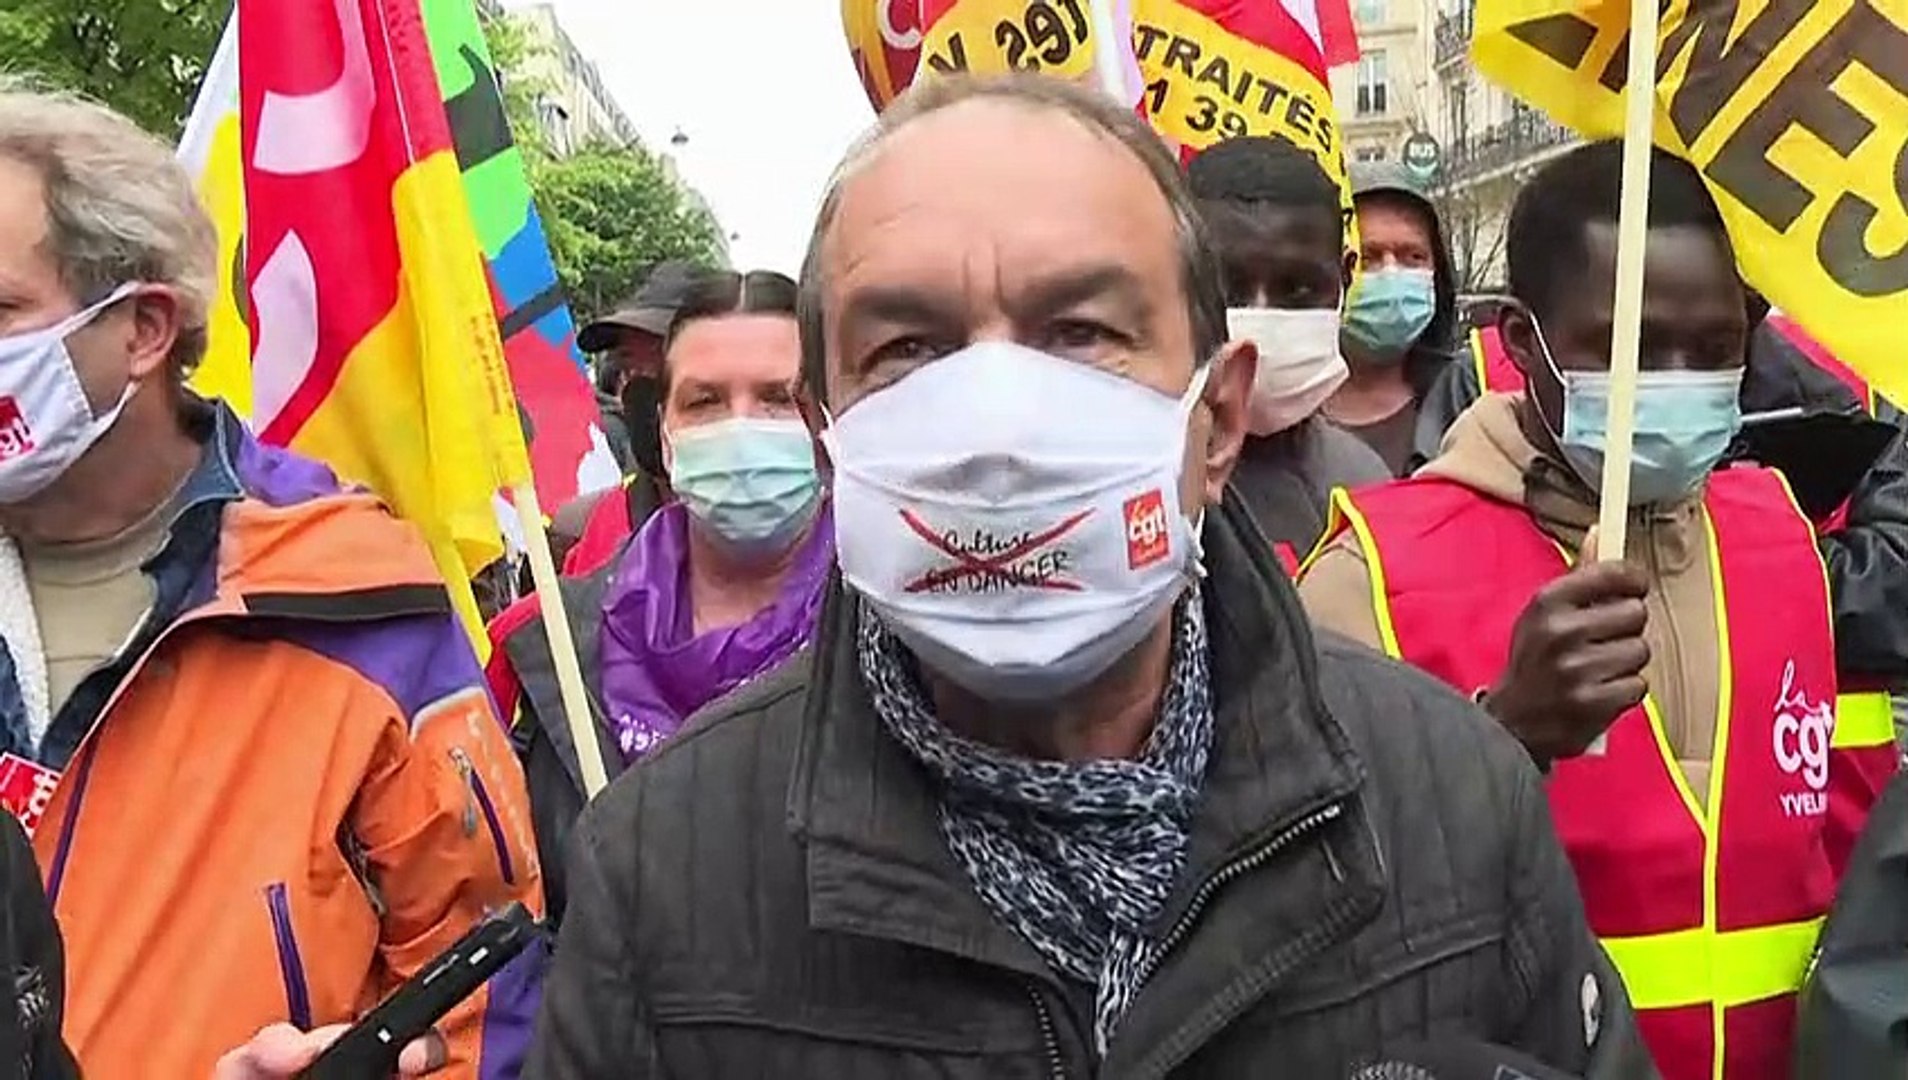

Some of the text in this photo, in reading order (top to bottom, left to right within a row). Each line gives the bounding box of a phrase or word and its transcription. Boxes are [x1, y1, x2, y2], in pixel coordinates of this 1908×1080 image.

[1131, 24, 1334, 154] TRAITÉS
[967, 551, 1069, 594] DANGER
[1779, 791, 1828, 817] YVELI
